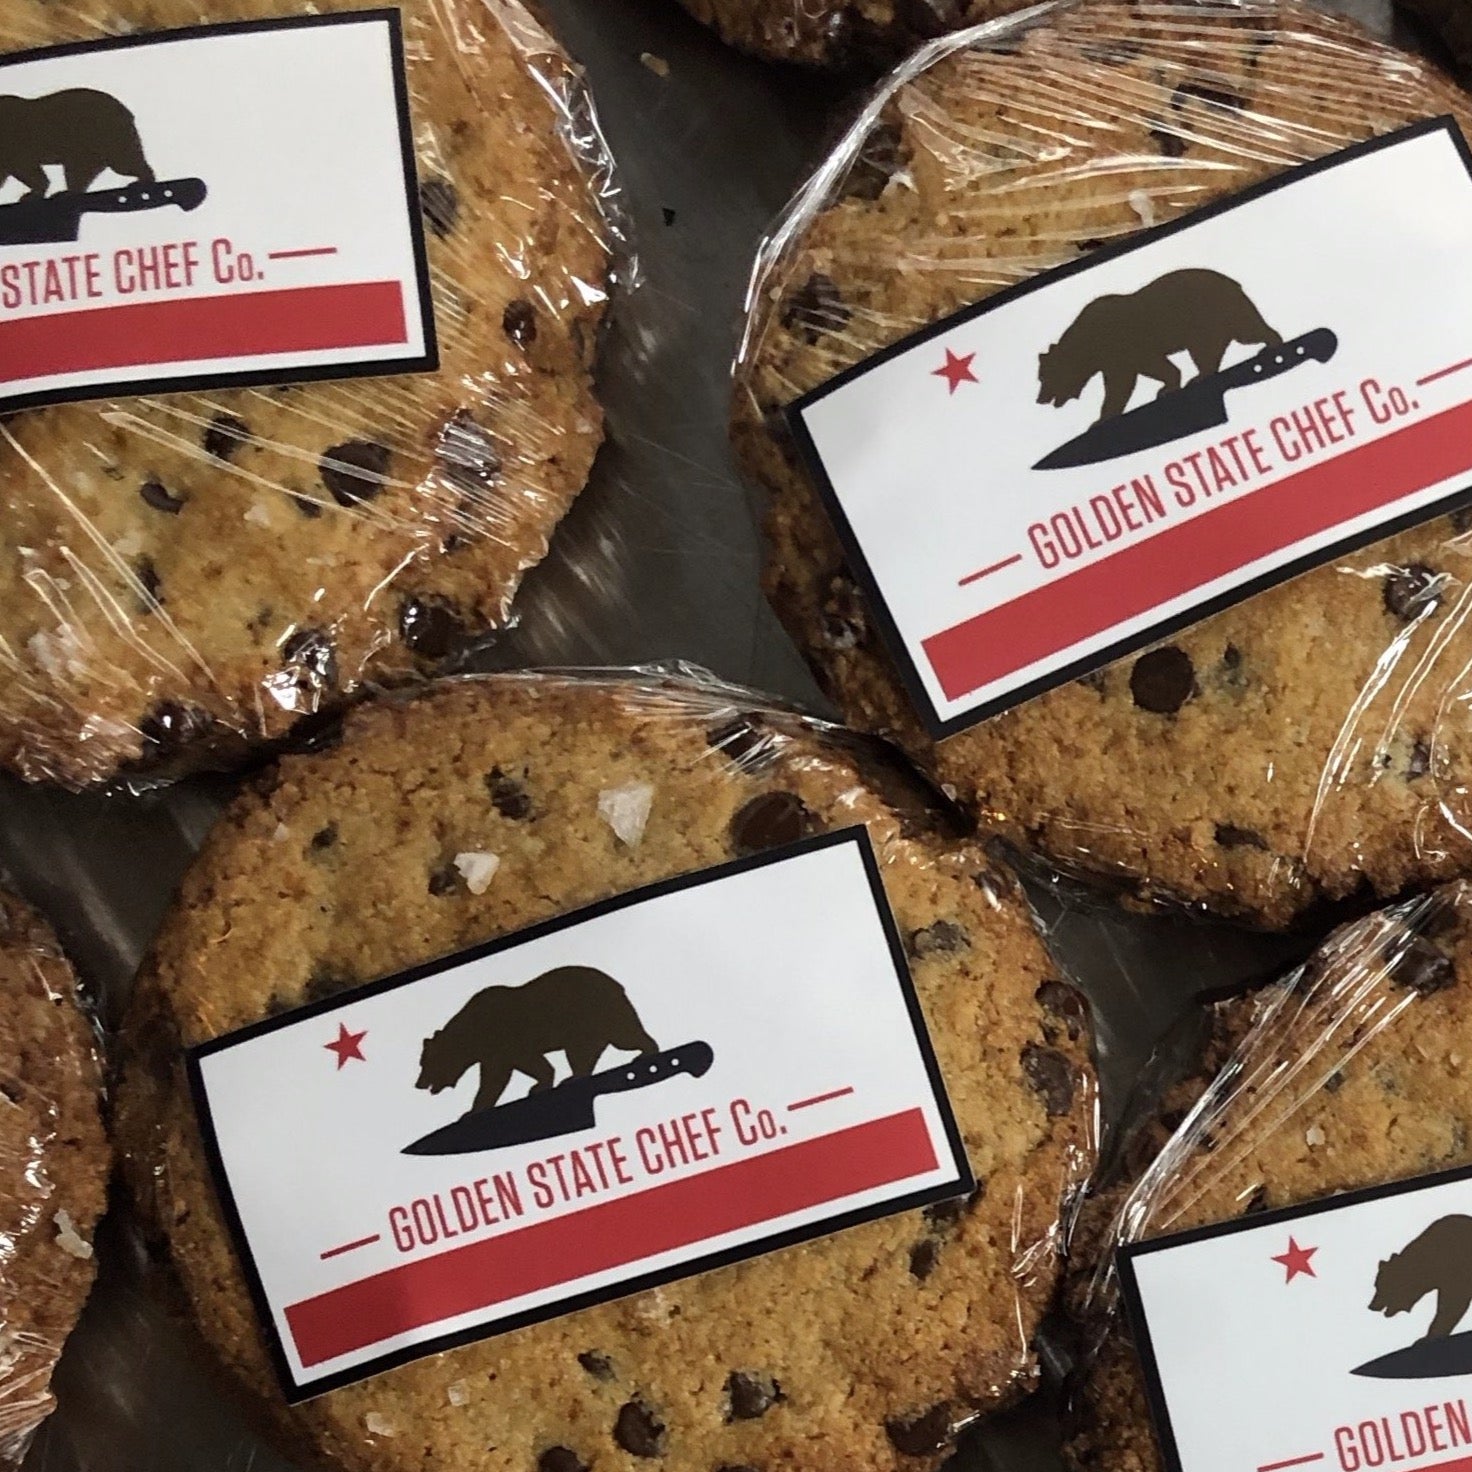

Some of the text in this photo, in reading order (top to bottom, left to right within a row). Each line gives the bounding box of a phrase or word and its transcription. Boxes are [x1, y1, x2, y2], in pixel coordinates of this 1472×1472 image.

[0, 252, 103, 310] STATE
[112, 240, 199, 296] CHEF
[1027, 474, 1168, 570] GOLDEN
[1164, 427, 1273, 508] STATE
[1269, 389, 1356, 463] CHEF
[388, 1171, 525, 1253] GOLDEN
[526, 1136, 634, 1209] STATE
[635, 1107, 721, 1175] CHEF
[1334, 1399, 1472, 1472] GOLDEN
